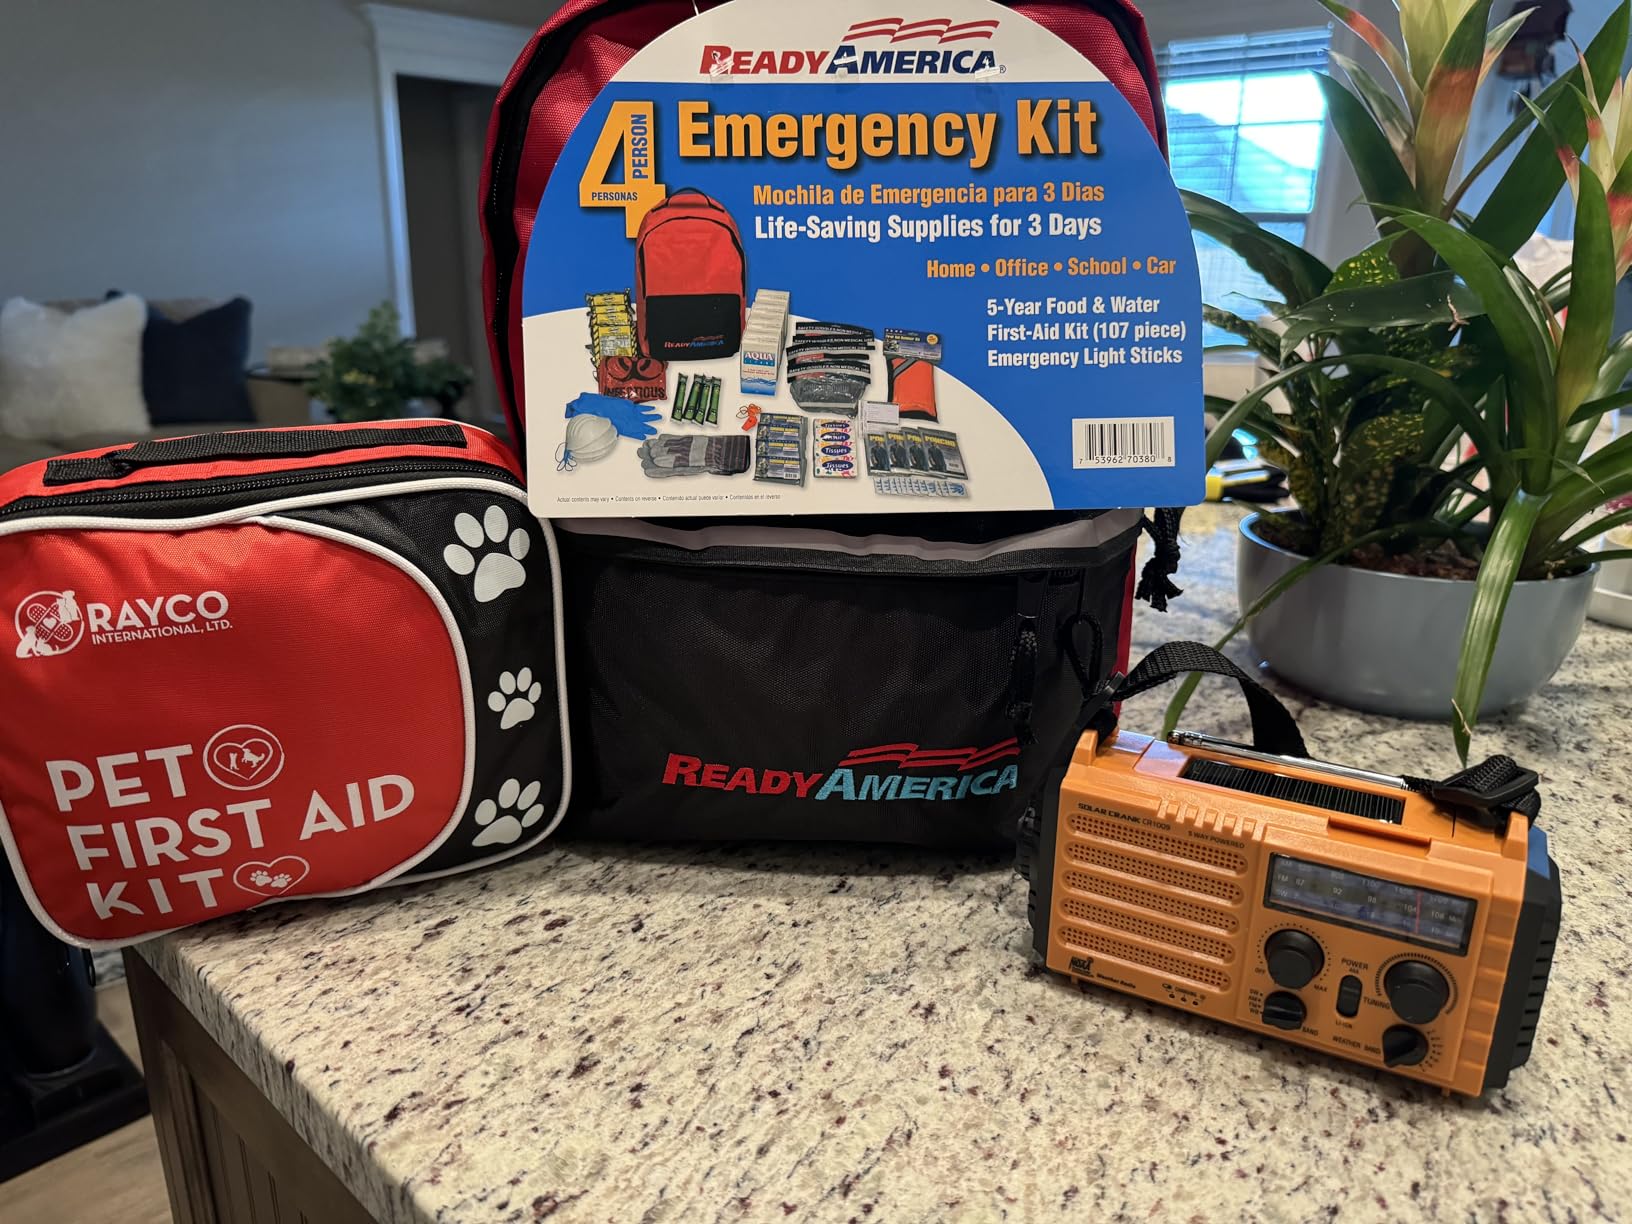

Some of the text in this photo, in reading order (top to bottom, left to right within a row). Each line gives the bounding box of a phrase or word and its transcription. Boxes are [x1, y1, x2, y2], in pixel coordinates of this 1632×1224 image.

[631, 114, 648, 179] PERSON
[678, 99, 1098, 171] Emergency Kit
[579, 101, 666, 239] 4
[591, 191, 638, 201] PERSONAS
[753, 182, 1105, 208] Mochila de Emergencia para 3 Dias
[755, 213, 1102, 243] Life-Saving Supplies for 3 Days
[927, 256, 1177, 278] Home Office School Car
[987, 296, 1160, 316] 5-Year Food & Water
[987, 321, 1186, 341] First-Aid Kit (107 piece)
[744, 352, 774, 360] AQUA
[987, 346, 1183, 370] Emergency Light Sticks
[1095, 456, 1123, 464] 53962
[1127, 455, 1156, 463] 70380
[86, 590, 230, 633] RAYCO
[91, 618, 233, 646] INTERNATIONAL, LTD.
[45, 743, 193, 813] PET
[66, 773, 416, 871] FIRST AID
[1078, 802, 1108, 816] SOLAR
[1108, 810, 1142, 824] CRANK
[1209, 836, 1245, 849] POWERED
[86, 868, 224, 921] KIT
[1341, 958, 1369, 970] POWER
[1363, 996, 1391, 1010] TUNING
[1332, 1036, 1361, 1049] WEATHER
